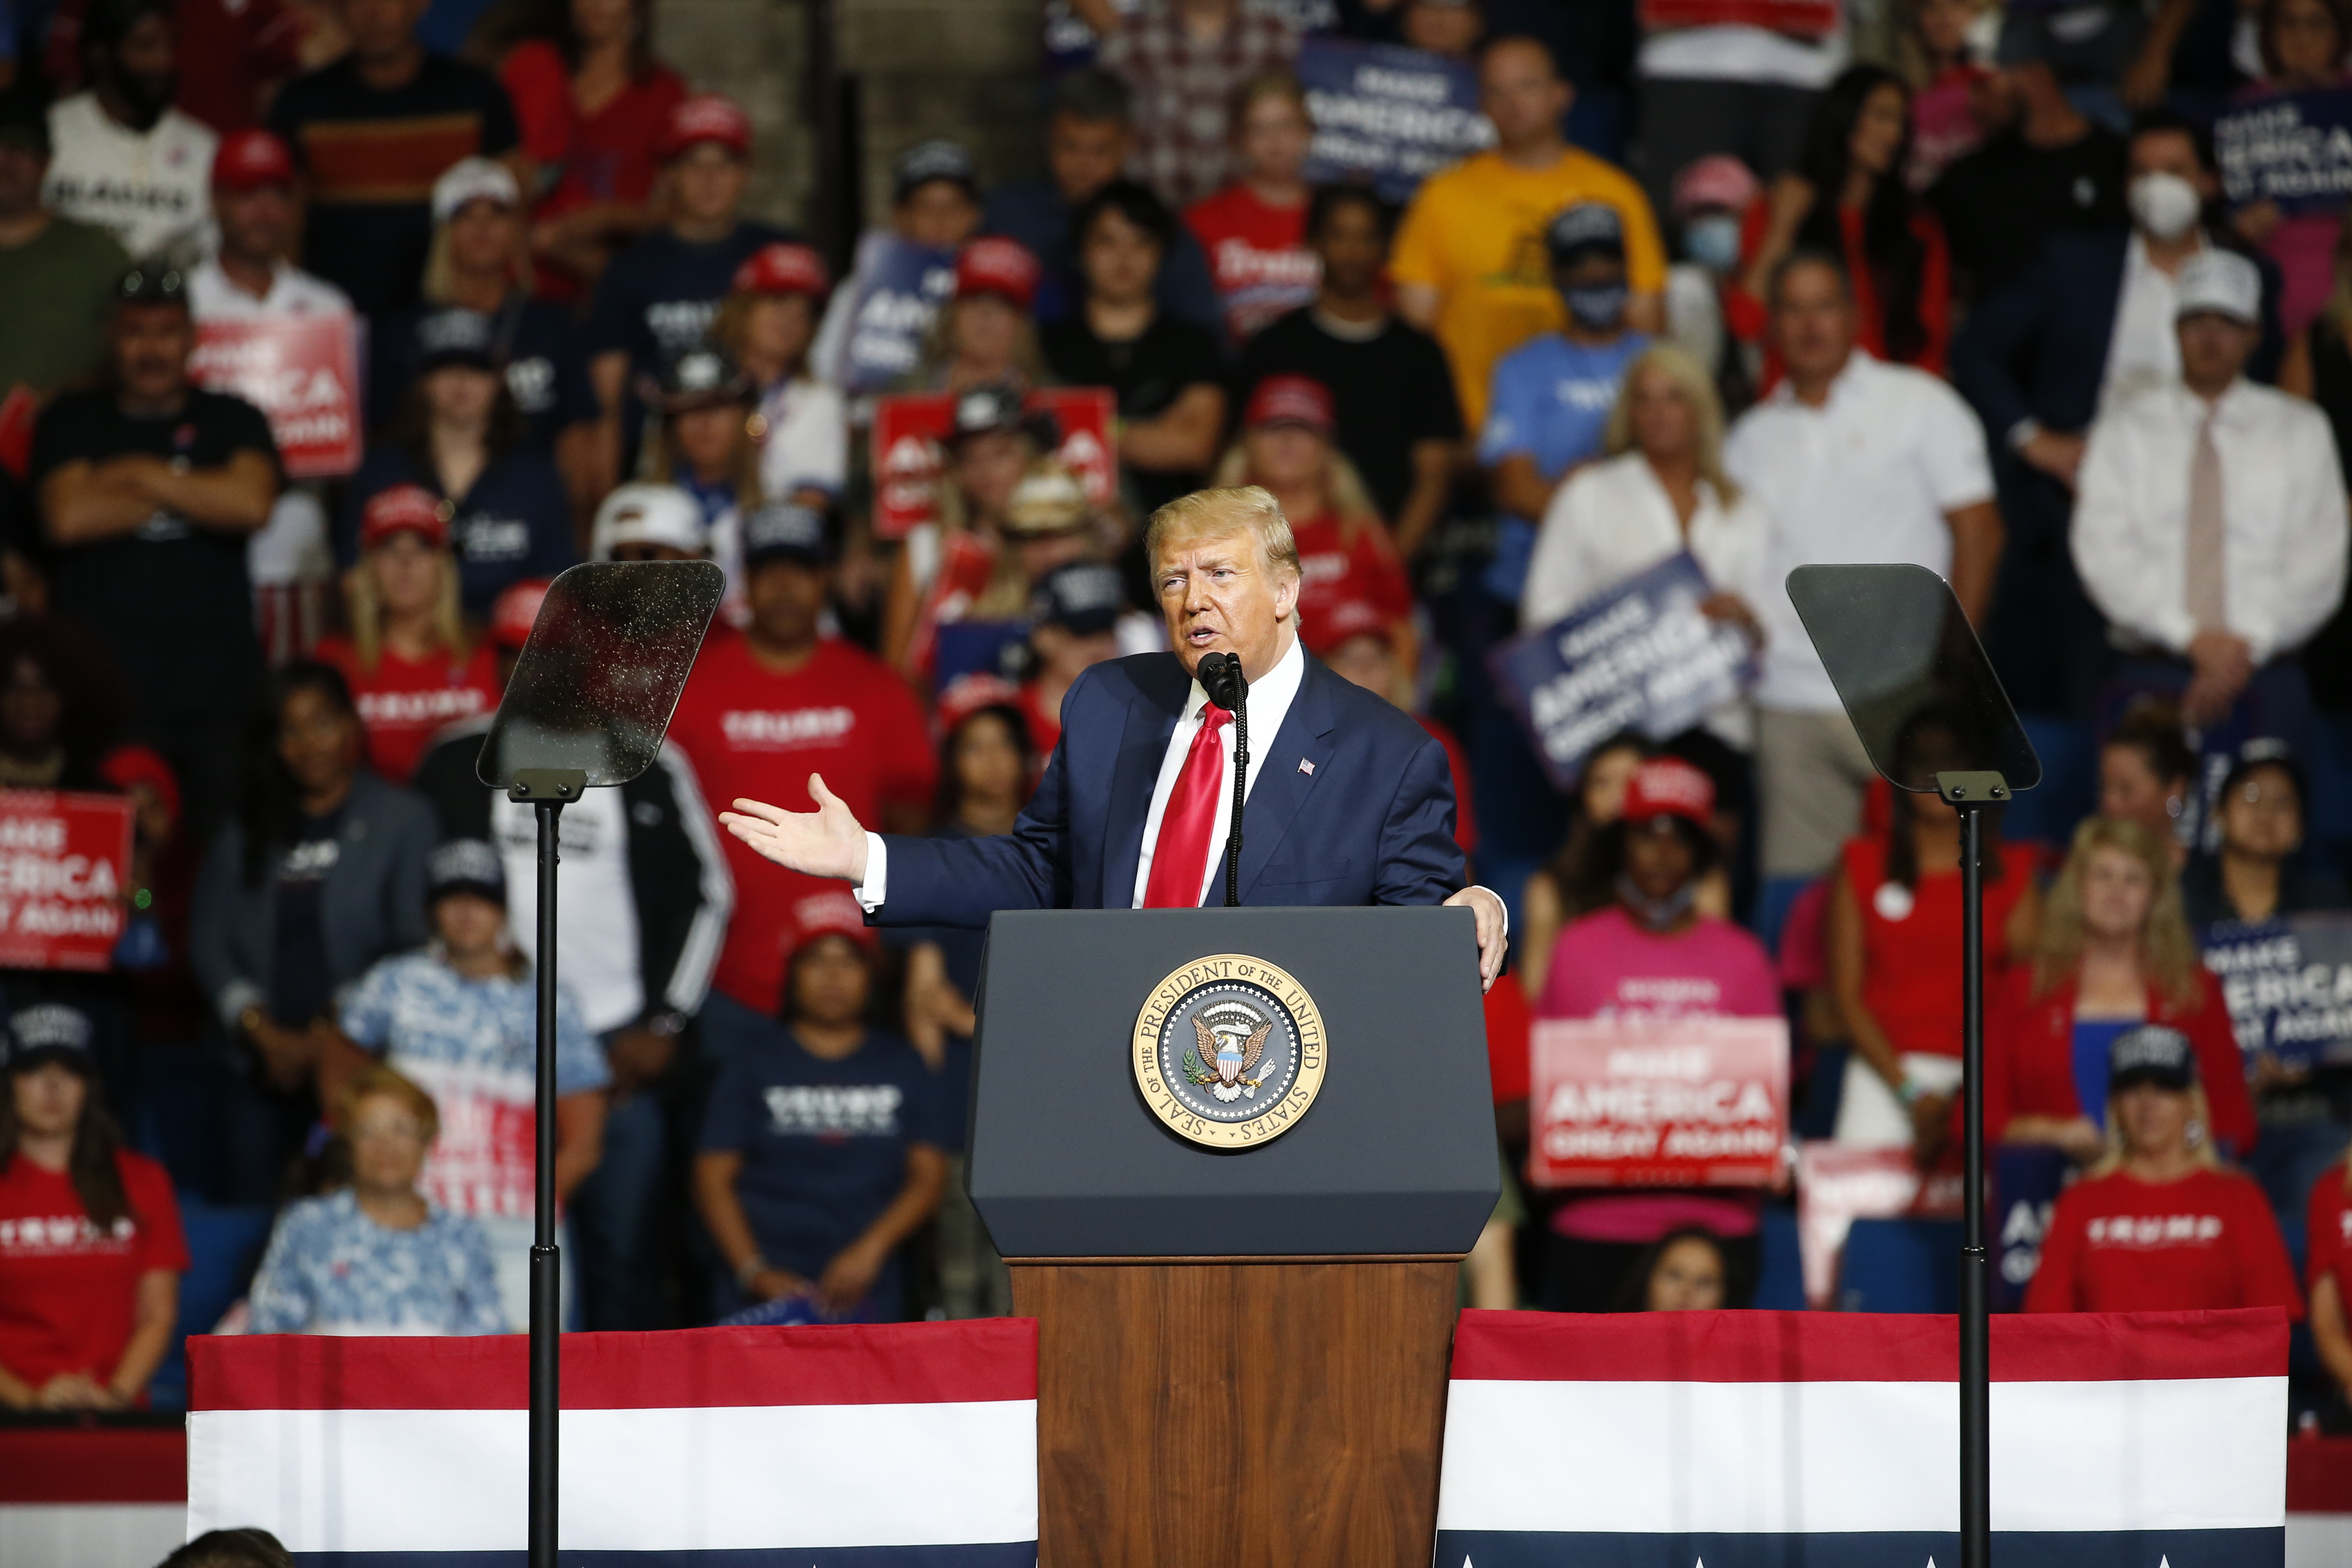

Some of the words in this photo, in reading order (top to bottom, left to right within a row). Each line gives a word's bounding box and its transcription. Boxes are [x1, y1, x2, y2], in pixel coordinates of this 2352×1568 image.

[1353, 64, 1450, 104] MAKE
[355, 686, 485, 721] TRUMP
[721, 708, 854, 740] TRUMP
[1238, 964, 1256, 977] OF
[2205, 939, 2299, 972] MAKE
[1260, 970, 1283, 990] THE
[1141, 961, 1232, 1039] PRESIDENT
[1285, 989, 1320, 1070] UNITED
[1142, 1047, 1154, 1073] THE
[763, 1084, 904, 1114] TRUMP
[1146, 1076, 1161, 1094] OF
[1159, 1093, 1206, 1136] SEAL
[1240, 1086, 1308, 1140] STATES
[1549, 1082, 1773, 1124] AMERICA
[1546, 1129, 1657, 1158] GREAT
[2087, 1215, 2223, 1240] TRUMP
